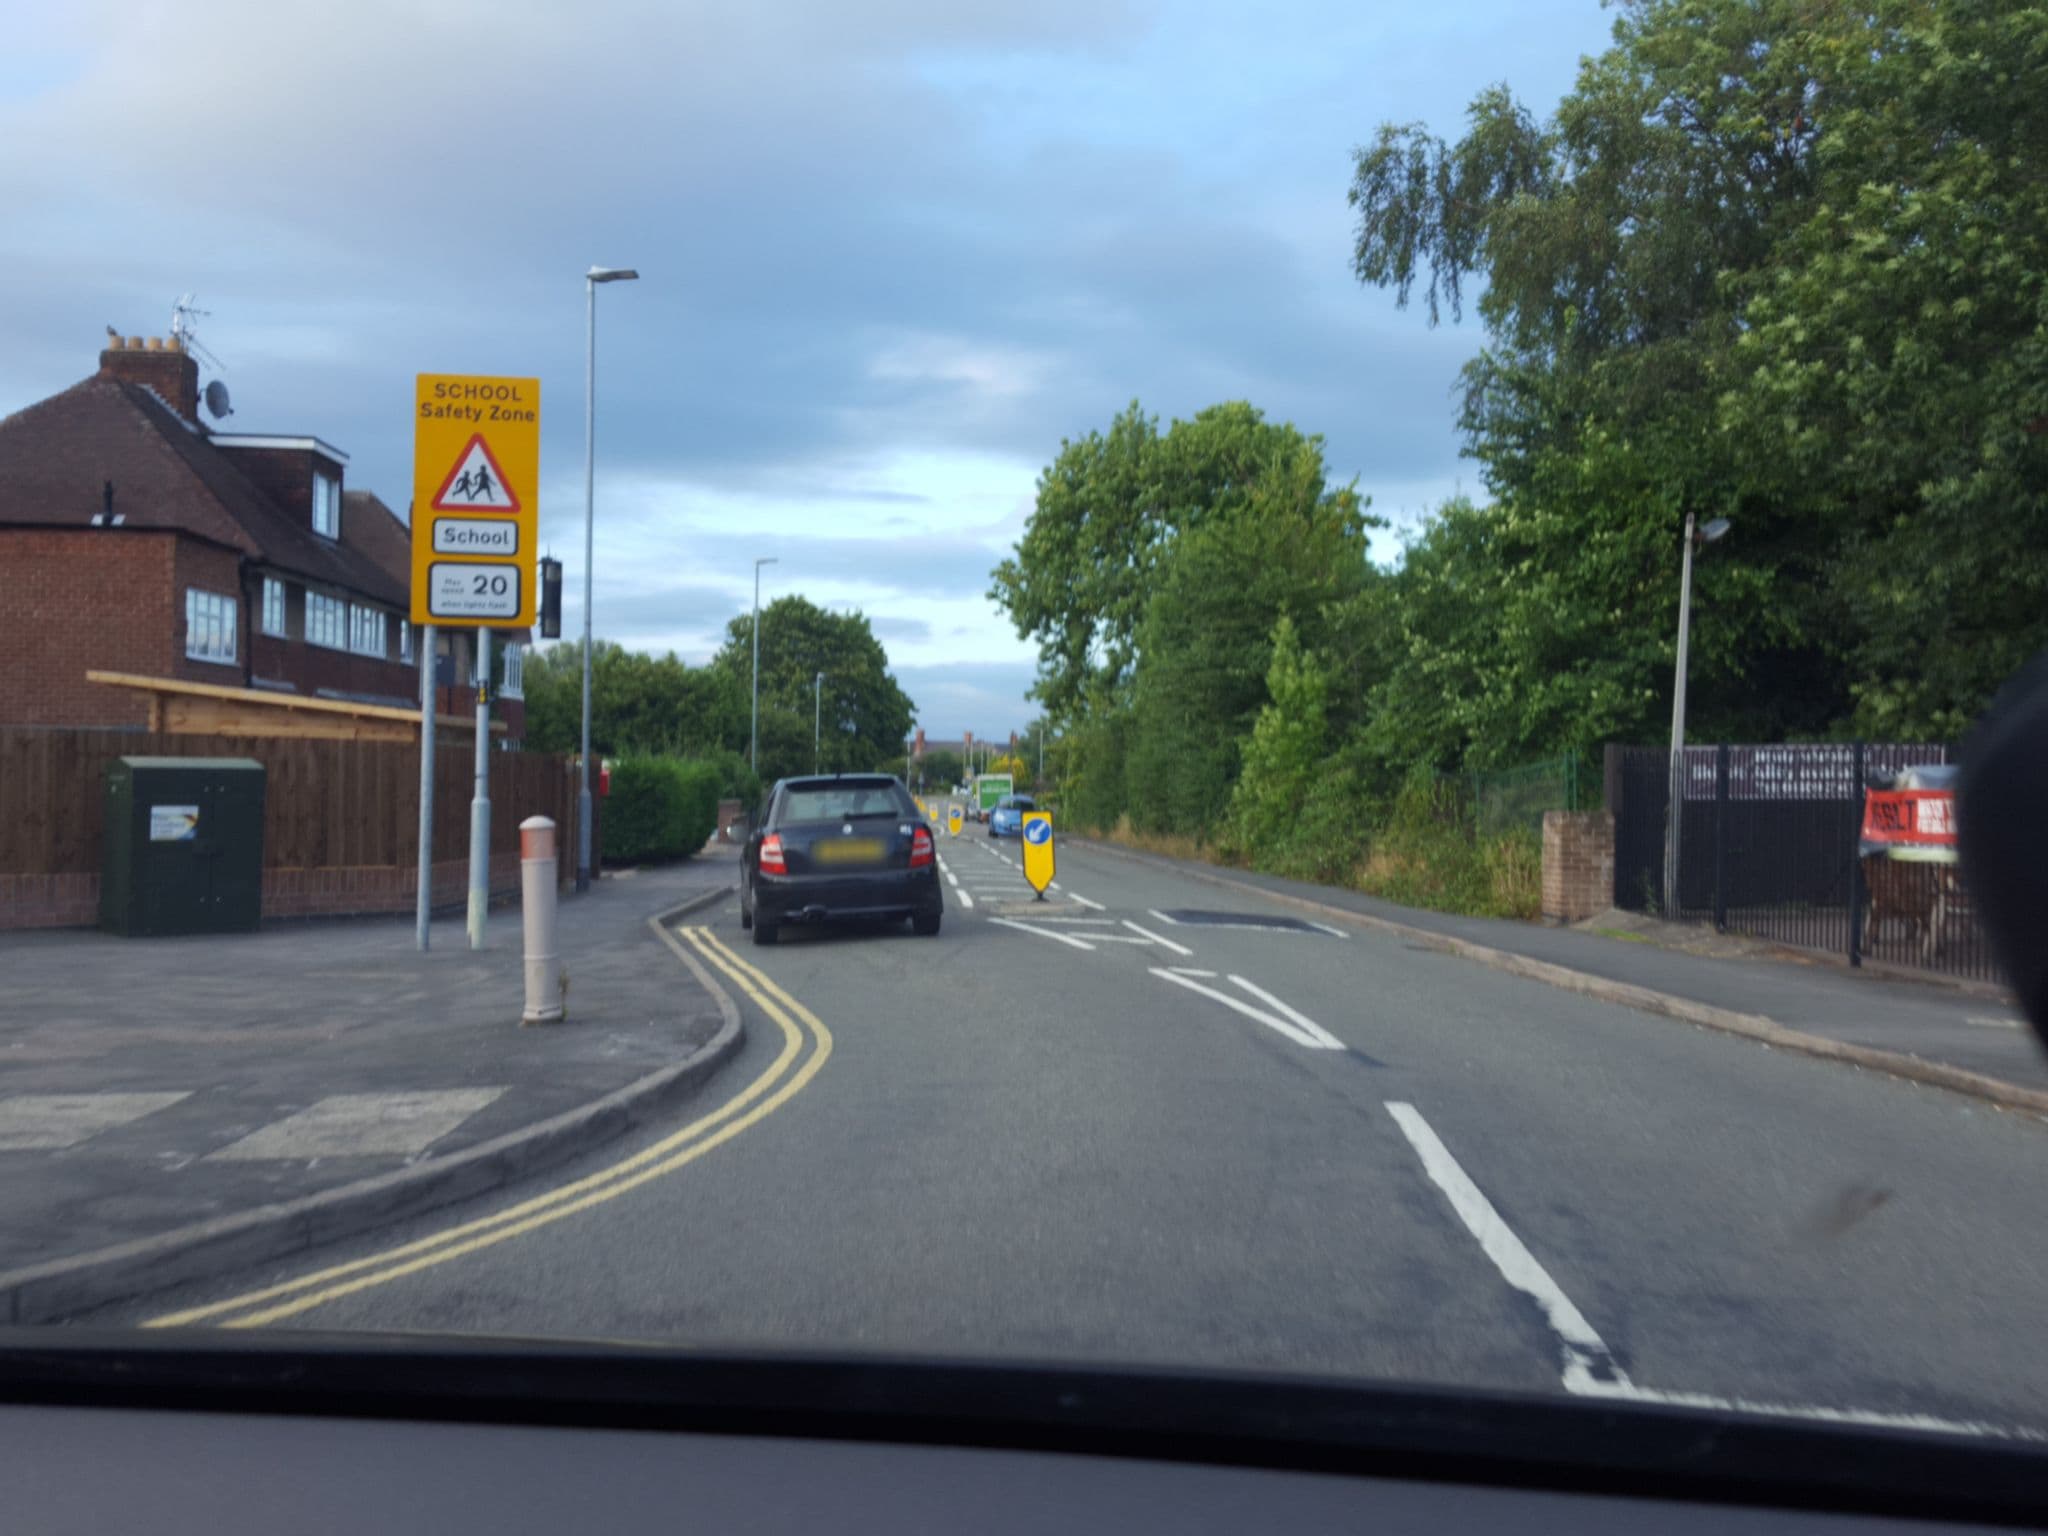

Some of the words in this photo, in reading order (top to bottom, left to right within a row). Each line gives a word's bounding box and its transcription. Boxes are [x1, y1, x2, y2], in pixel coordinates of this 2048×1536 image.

[435, 384, 522, 401] SCHOOL
[421, 402, 482, 423] Safety
[489, 404, 535, 422] Zone
[443, 527, 509, 545] School
[473, 574, 507, 596] 20
